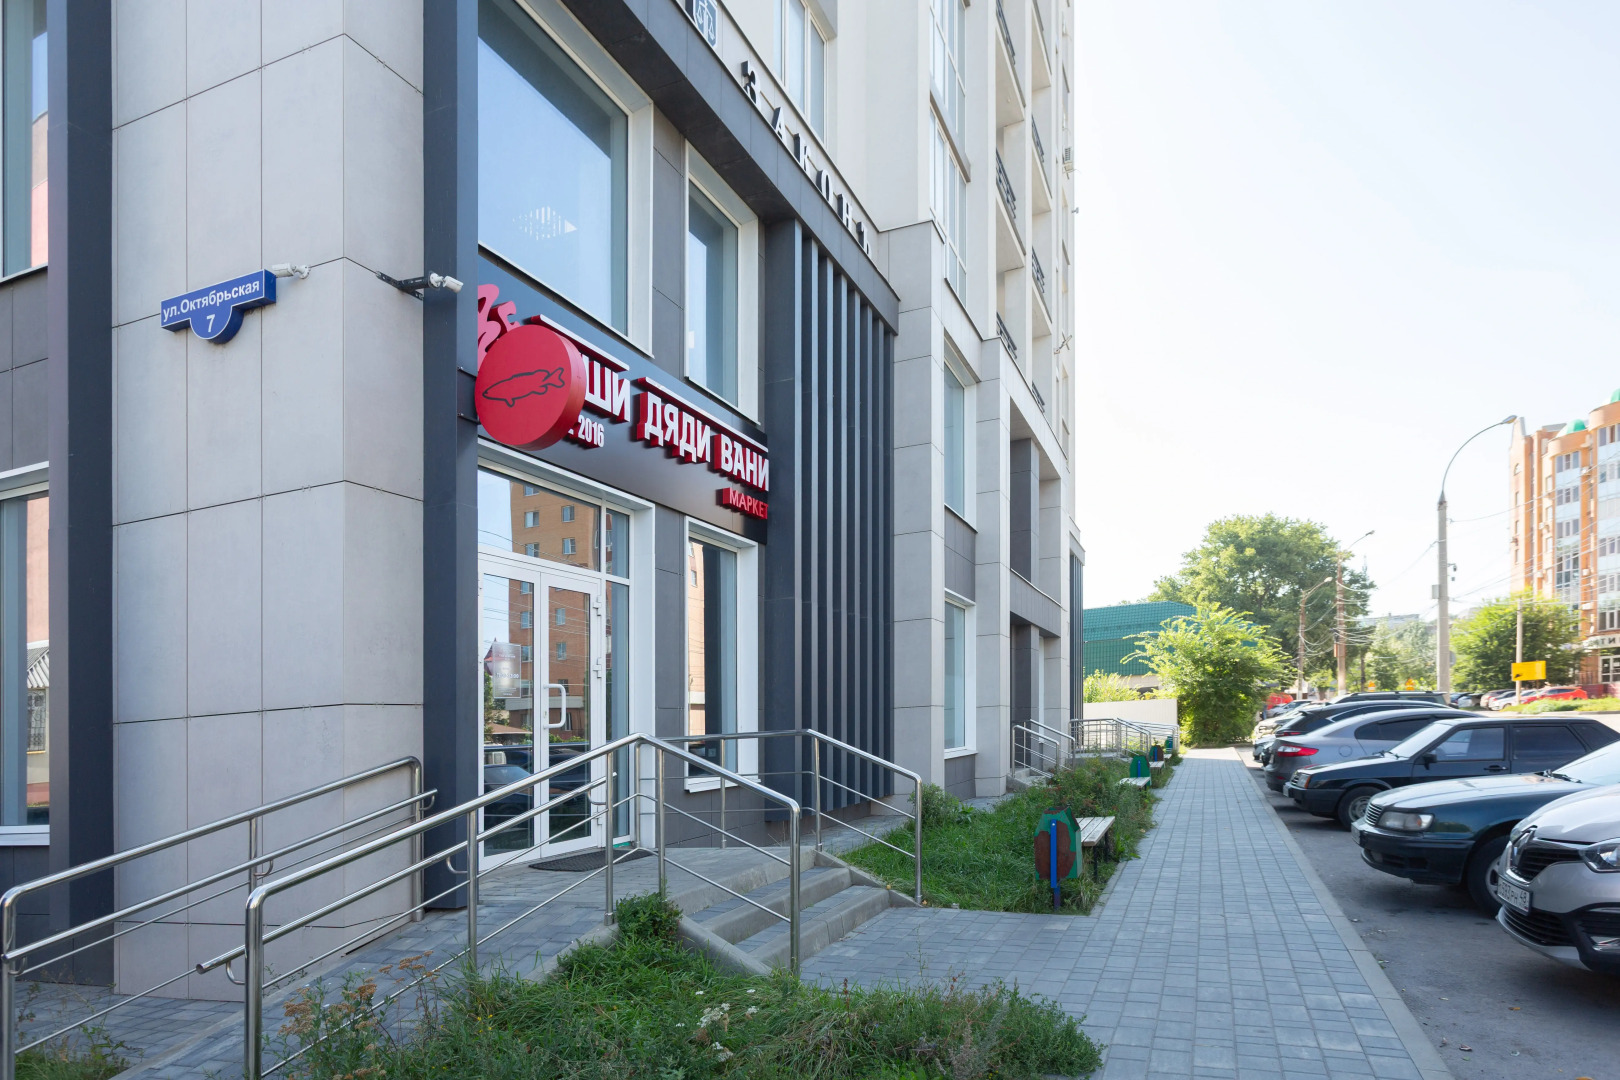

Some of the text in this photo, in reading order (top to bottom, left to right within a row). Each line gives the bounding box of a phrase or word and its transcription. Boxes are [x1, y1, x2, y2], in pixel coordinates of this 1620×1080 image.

[163, 280, 260, 322] ул.Октябрьская
[206, 313, 216, 333] 7
[577, 414, 605, 448] 2016
[581, 354, 769, 492] ШИ ДЯДИ ВАНИ
[729, 487, 769, 520] МАРКЕТ
